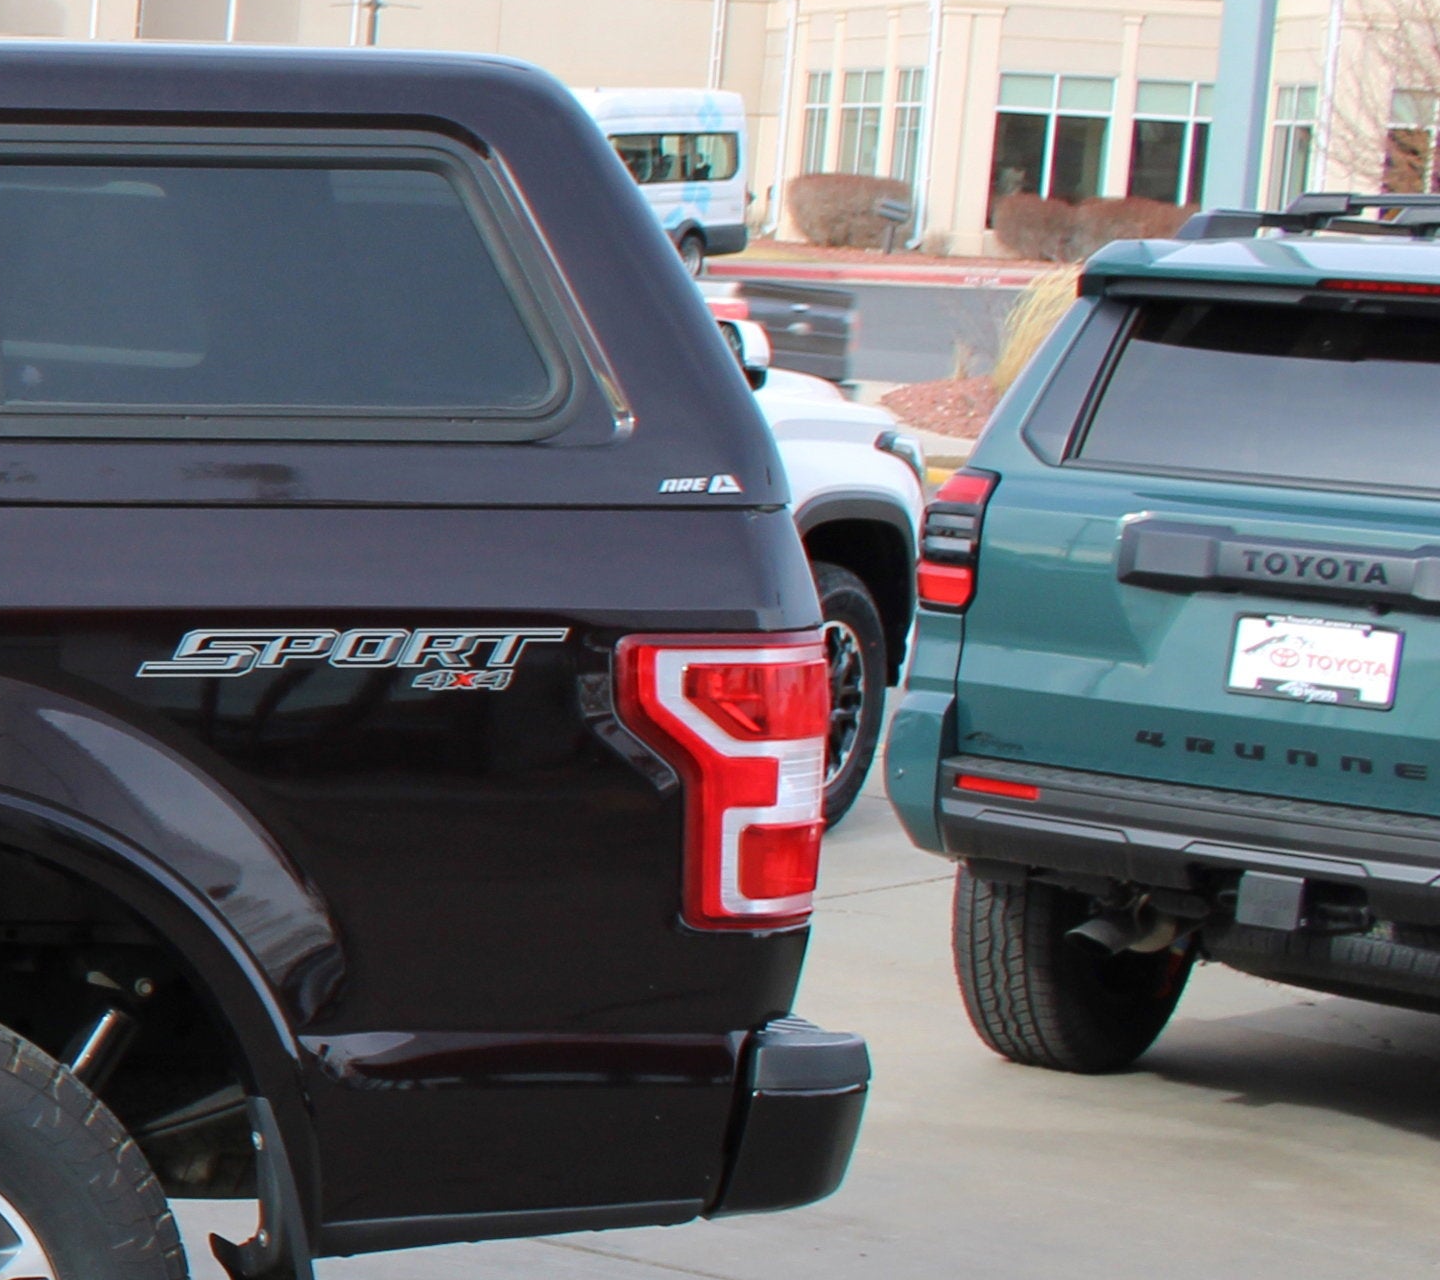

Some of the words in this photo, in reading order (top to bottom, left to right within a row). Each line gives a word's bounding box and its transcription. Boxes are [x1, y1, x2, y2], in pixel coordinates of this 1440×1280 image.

[1242, 550, 1388, 585] TOYOTA
[136, 627, 570, 678] SPORT
[1306, 653, 1390, 677] TOYOTA
